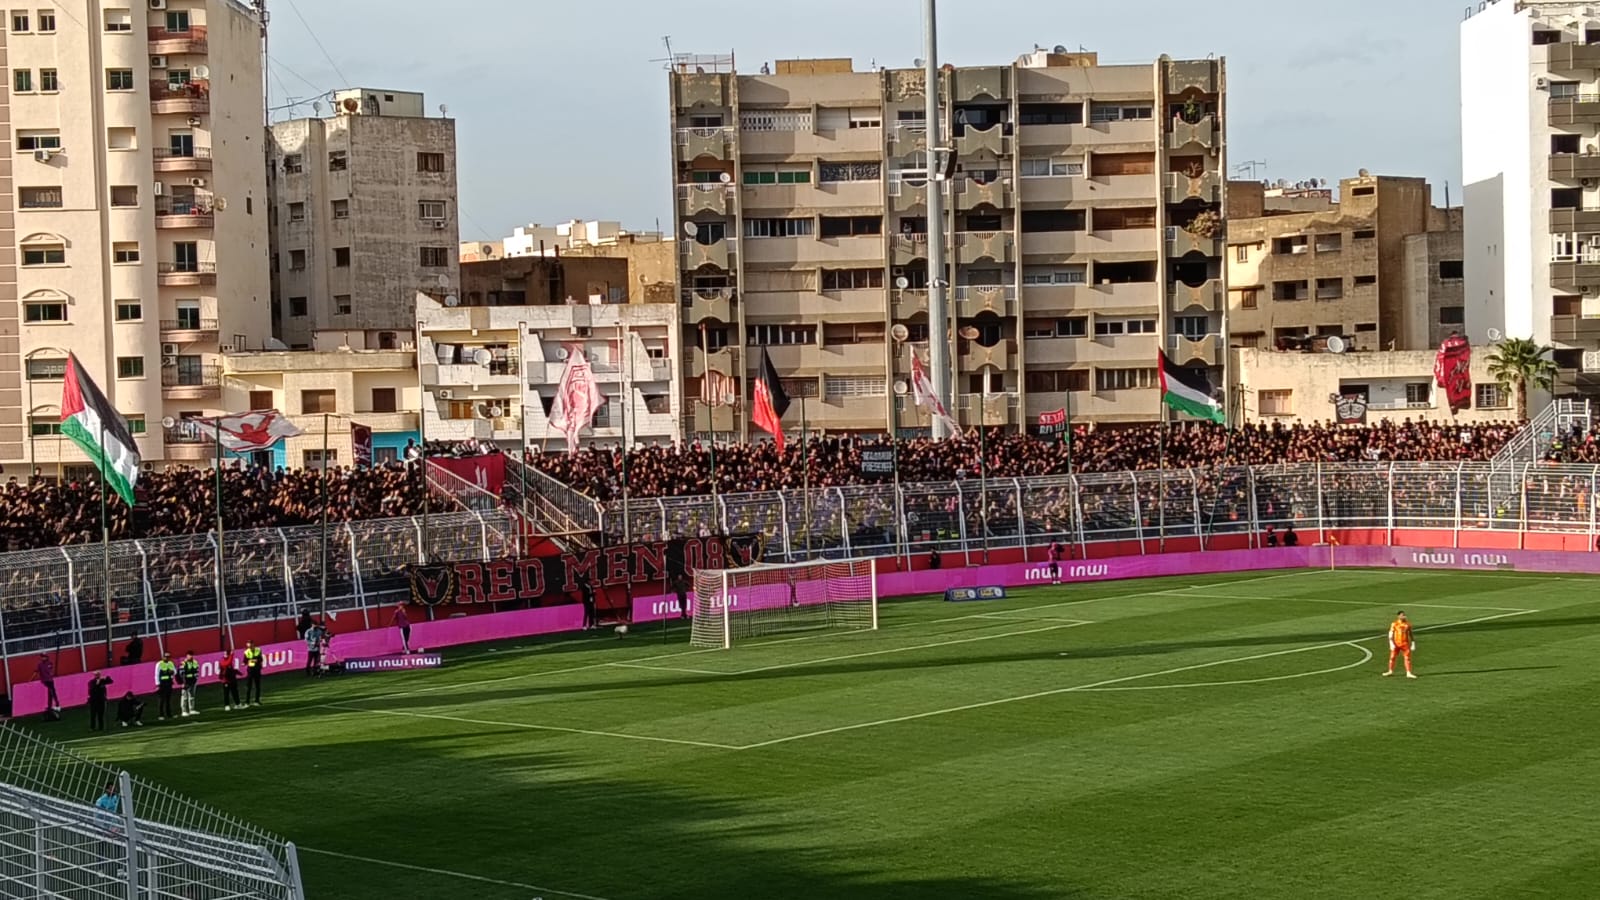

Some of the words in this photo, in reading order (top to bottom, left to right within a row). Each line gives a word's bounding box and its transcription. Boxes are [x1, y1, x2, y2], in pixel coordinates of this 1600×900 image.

[454, 558, 545, 603] RED
[561, 543, 669, 592] MEN
[684, 537, 724, 576] 08
[1070, 564, 1108, 577] inwi
